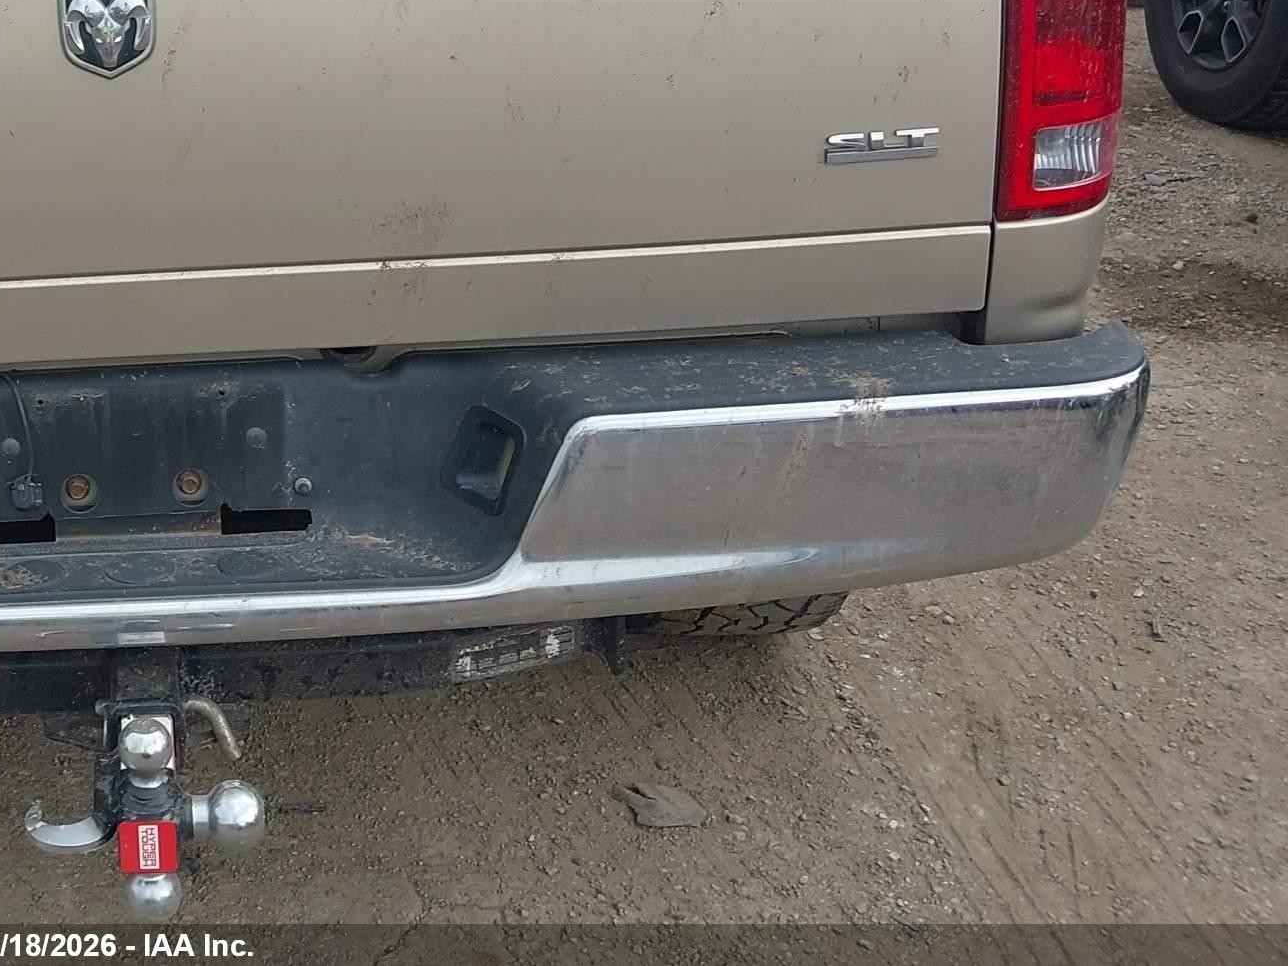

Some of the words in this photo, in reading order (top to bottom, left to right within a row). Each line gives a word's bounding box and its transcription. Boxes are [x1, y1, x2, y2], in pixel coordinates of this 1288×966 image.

[827, 127, 940, 152] SLT
[140, 826, 150, 867] TOUGH
[146, 827, 157, 867] HYPER
